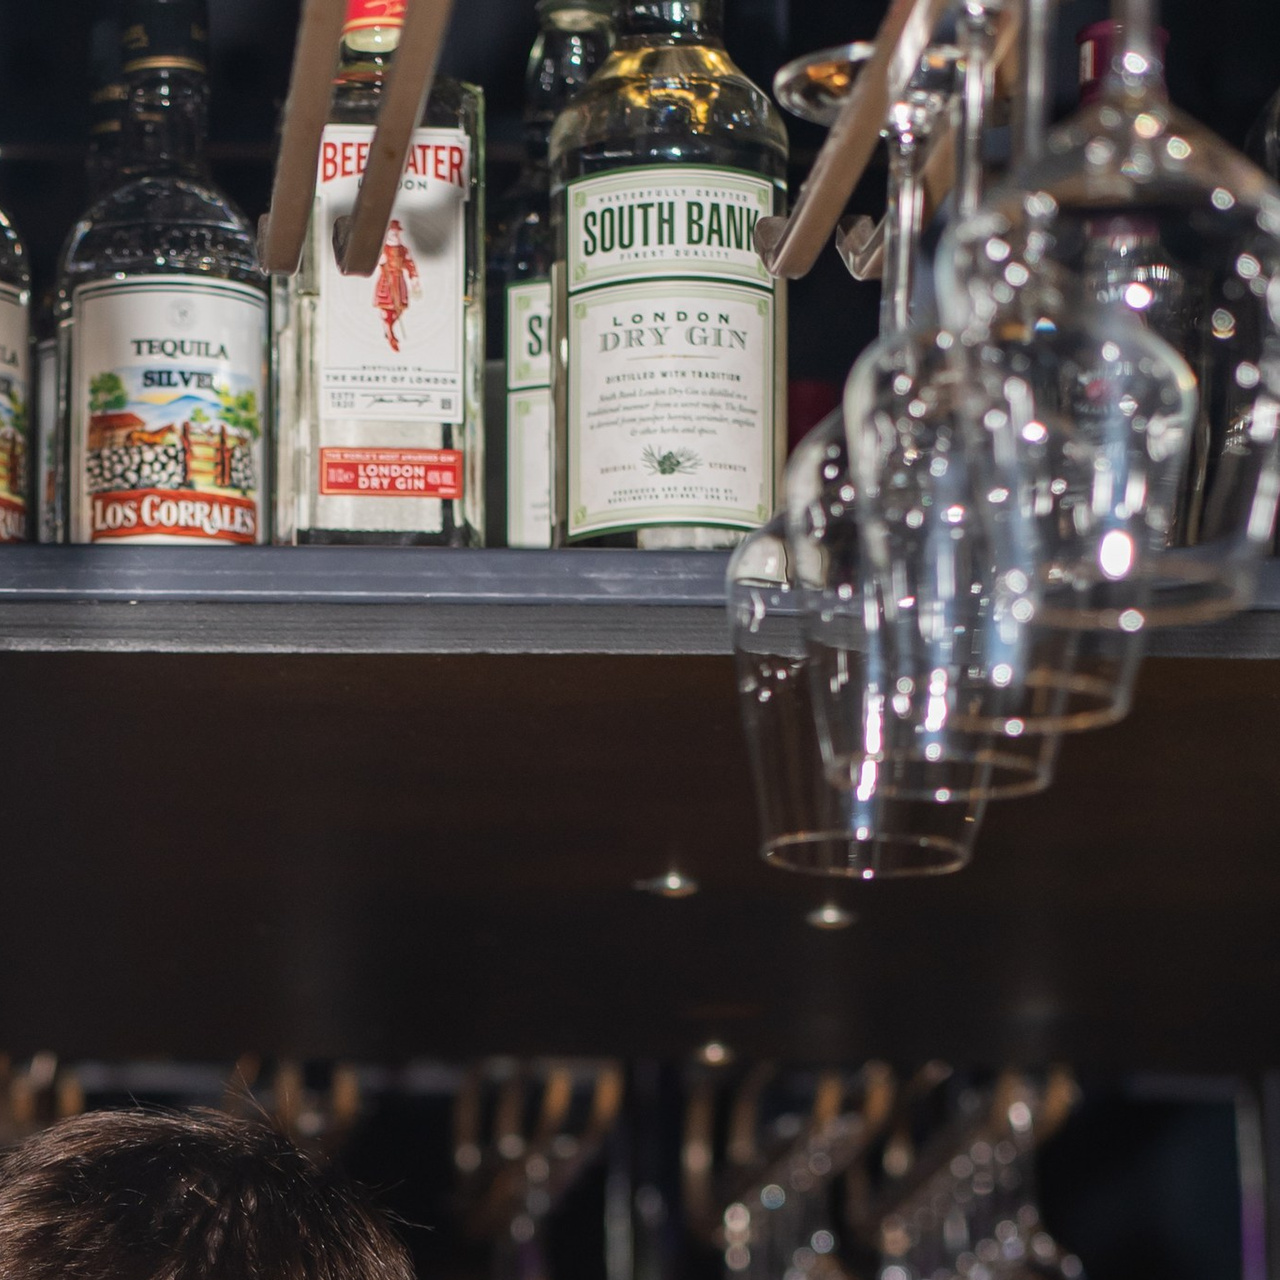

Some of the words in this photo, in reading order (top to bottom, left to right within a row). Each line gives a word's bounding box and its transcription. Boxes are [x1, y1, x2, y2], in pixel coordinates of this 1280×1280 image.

[322, 142, 464, 188] BEEATER
[583, 201, 675, 256] SOUTH
[687, 201, 760, 252] BANK
[613, 311, 730, 327] LONDON
[131, 339, 229, 360] TEQUILA
[599, 326, 672, 353] DRY
[685, 326, 749, 351] GIN
[351, 375, 387, 383] HEART
[410, 376, 457, 385] LONDON
[358, 464, 425, 478] LONDON
[358, 477, 391, 489] DRY
[395, 477, 425, 490] GIN
[94, 499, 137, 530] LOS
[141, 494, 256, 536] CORRALES
